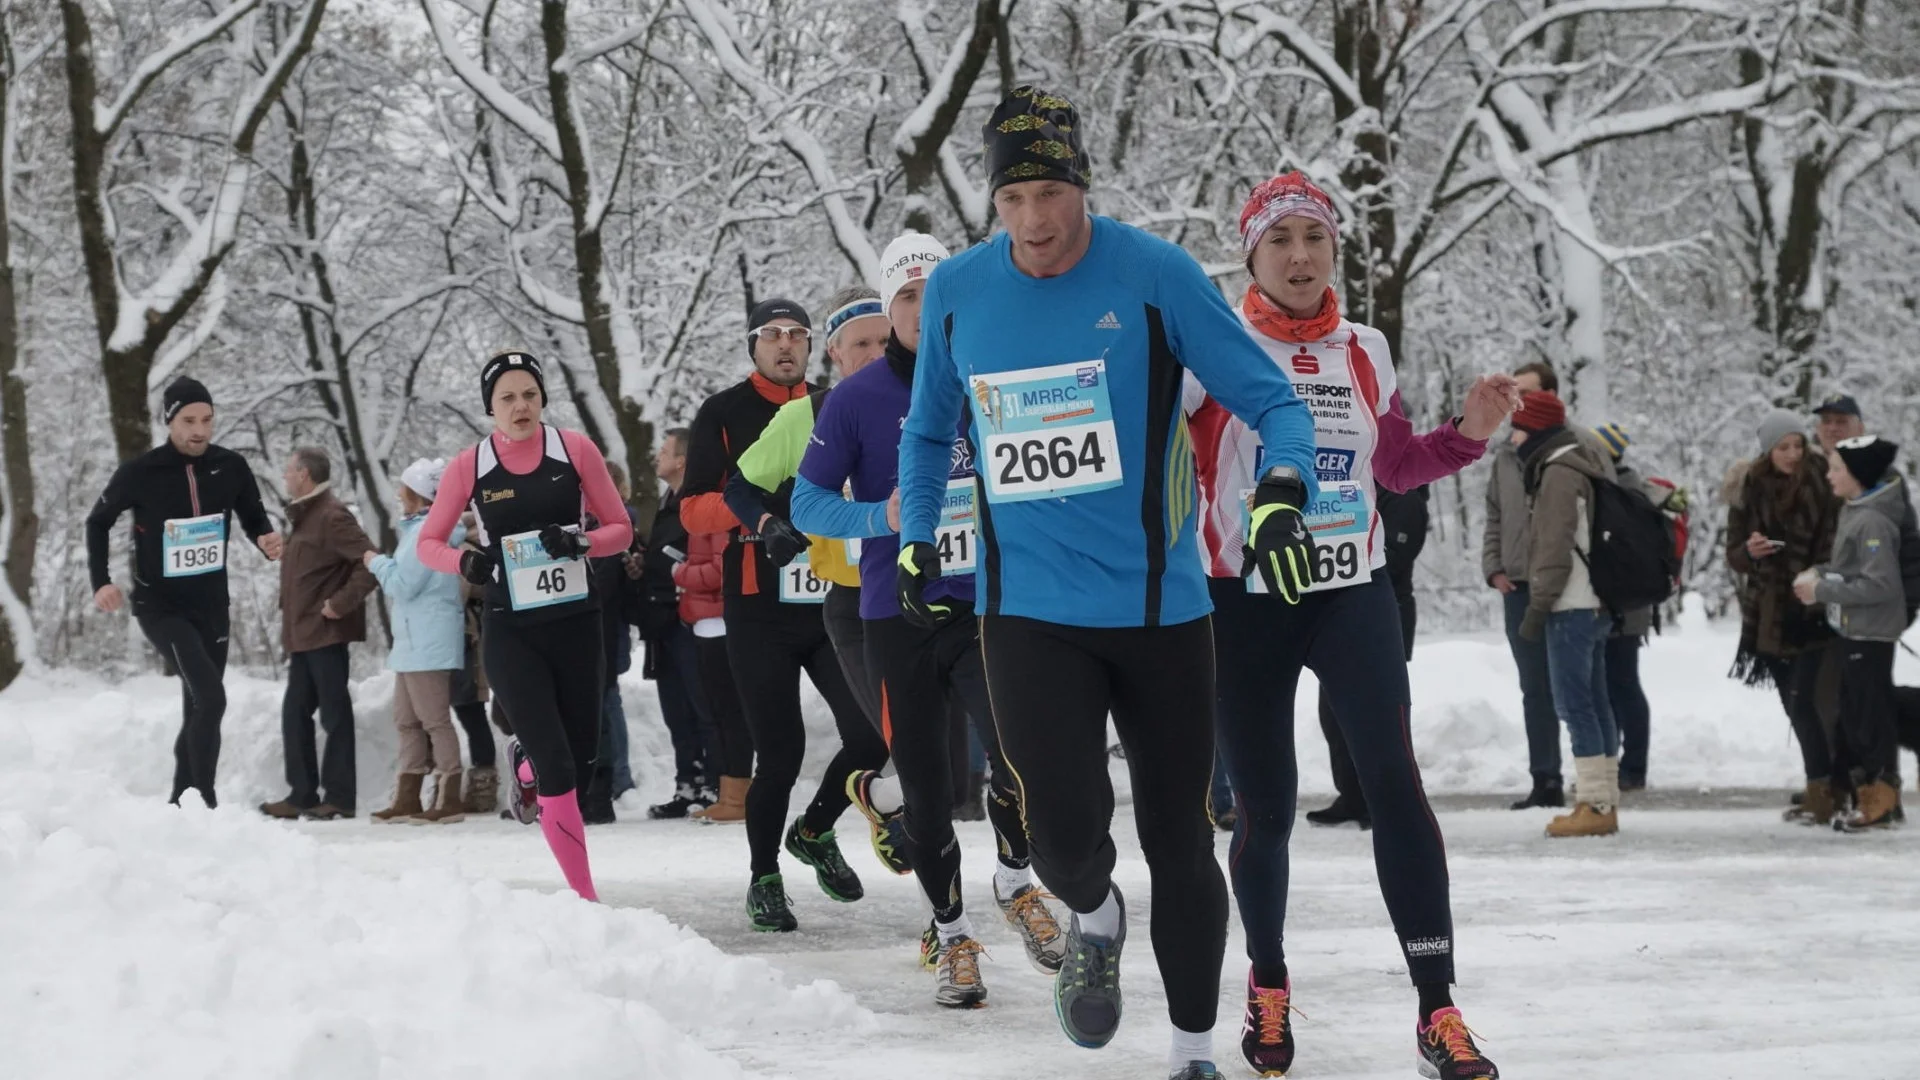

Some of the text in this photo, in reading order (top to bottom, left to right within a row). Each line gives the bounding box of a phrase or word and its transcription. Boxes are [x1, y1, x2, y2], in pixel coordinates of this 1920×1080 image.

[1022, 386, 1078, 407] MRRC
[1312, 410, 1350, 420] AIBURG
[994, 431, 1106, 485] 2664
[172, 545, 219, 569] 1936
[936, 529, 976, 564] 41
[1315, 541, 1358, 583] 69
[536, 567, 566, 594] 46
